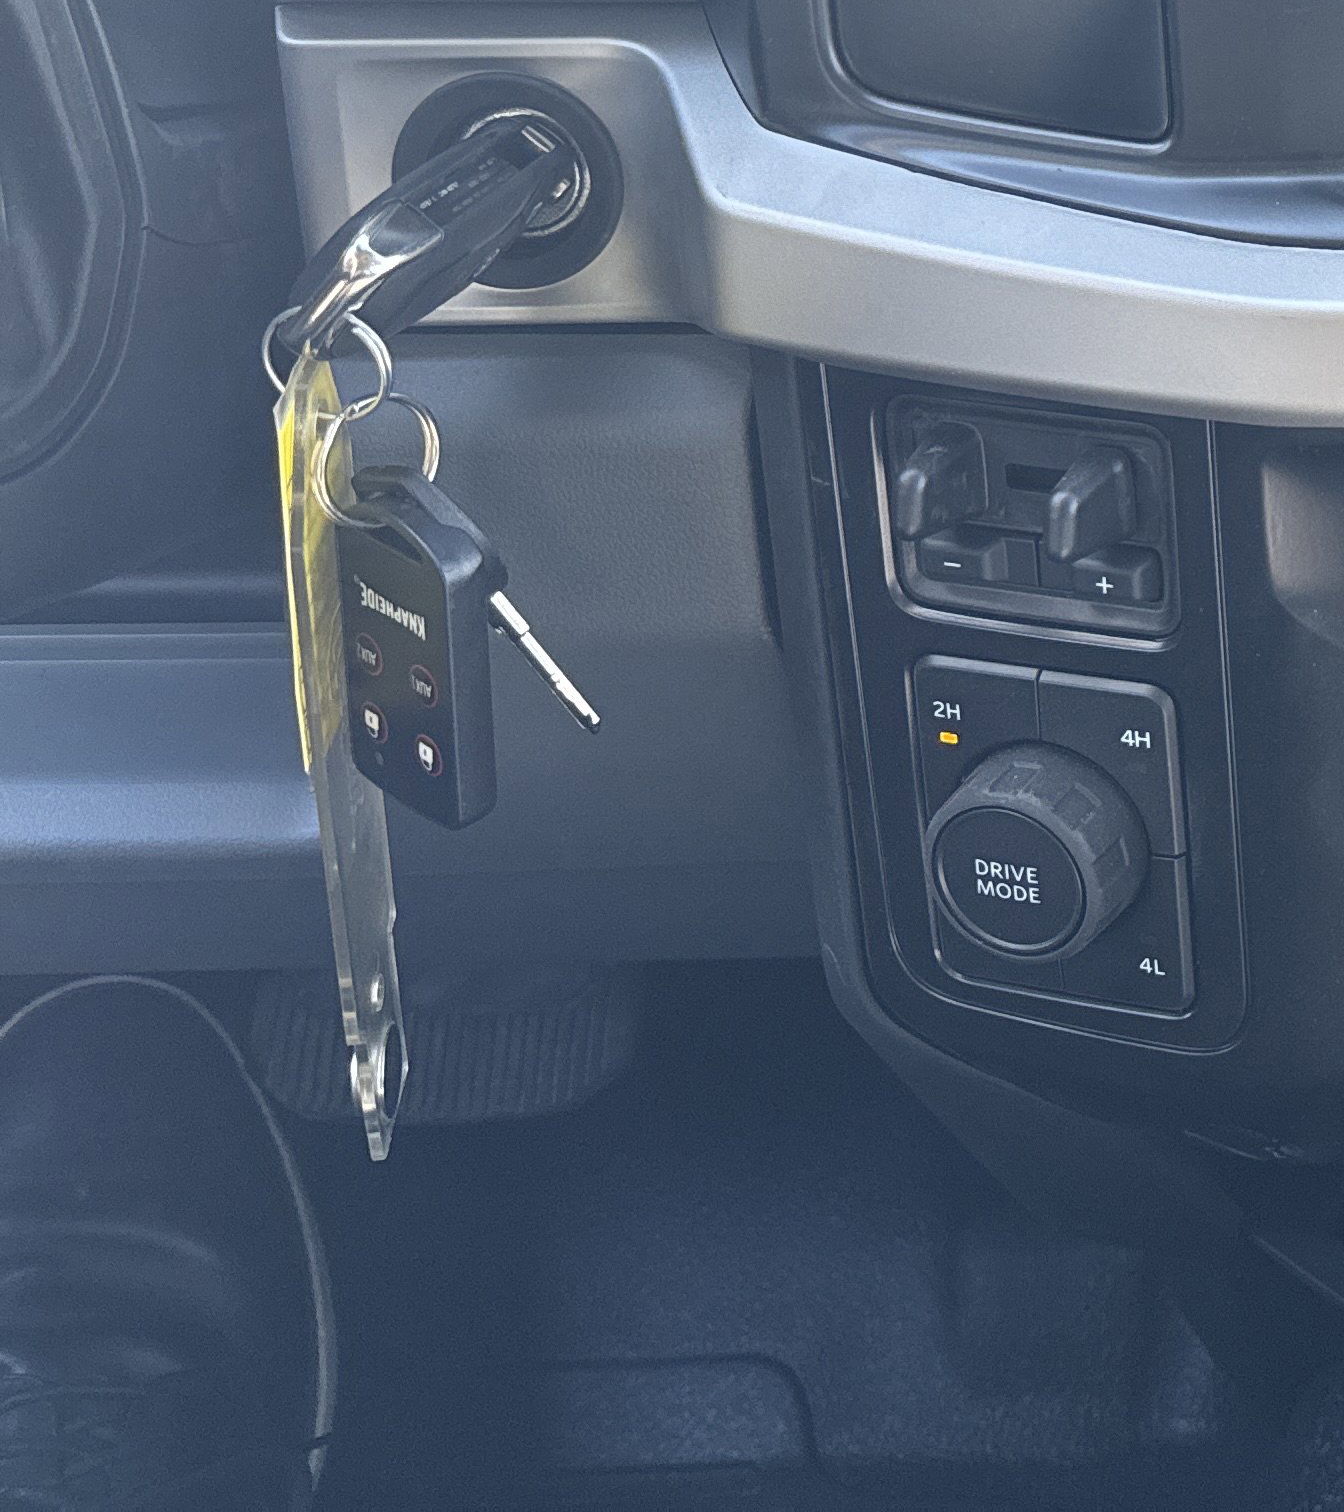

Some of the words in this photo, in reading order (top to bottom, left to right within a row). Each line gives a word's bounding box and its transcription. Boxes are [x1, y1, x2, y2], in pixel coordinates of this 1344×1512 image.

[359, 582, 426, 641] KNAPHEIDE
[932, 700, 961, 721] 2H
[1120, 729, 1151, 749] 4H
[974, 858, 1039, 885] DRIVE
[977, 878, 1042, 905] MODE
[1139, 957, 1166, 976] 4L
